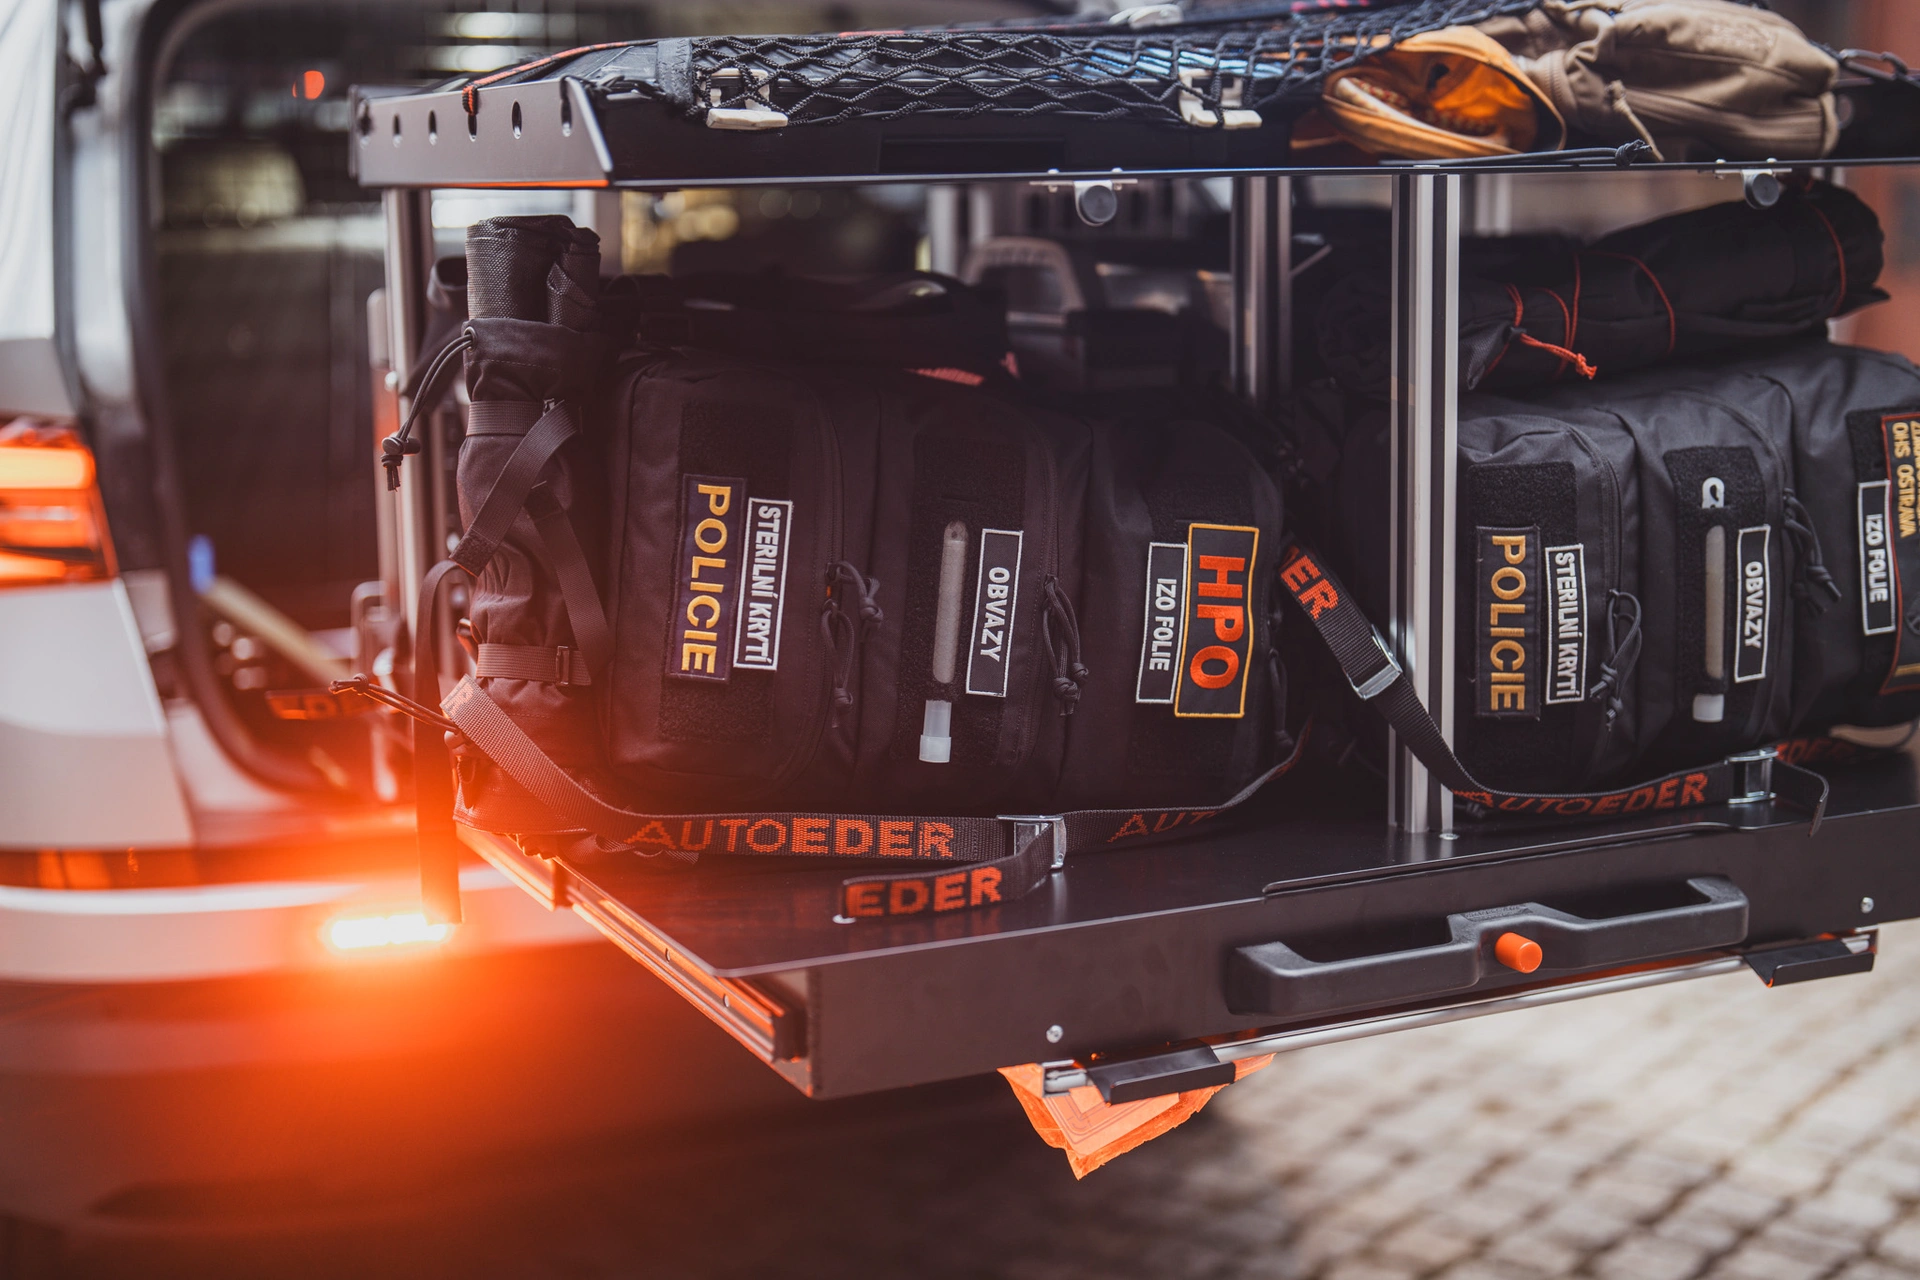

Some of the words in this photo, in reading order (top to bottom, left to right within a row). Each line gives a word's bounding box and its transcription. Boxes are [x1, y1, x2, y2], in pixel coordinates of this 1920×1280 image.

[1866, 513, 1884, 546] IZO
[1896, 463, 1917, 538] OSTRAVA
[681, 483, 732, 674] POLICIE
[750, 505, 782, 600] STERILNÍ
[1867, 548, 1888, 603] FOLIE
[980, 566, 1011, 663] OBVAZY
[1155, 578, 1177, 611] IZO
[1190, 554, 1246, 690] HPO
[1490, 535, 1527, 711] POLICIE
[1554, 551, 1582, 639] STERILNÍ
[1744, 560, 1764, 649] OBVAZY
[744, 602, 773, 664] KRYTÍ
[1149, 616, 1175, 671] FOLIE
[1556, 642, 1580, 697] KRYTÍ
[1453, 772, 1709, 816] AUTOEDER
[624, 817, 955, 857] AUTOEDER
[1106, 810, 1222, 843] AUT
[845, 866, 1003, 917] EDER
